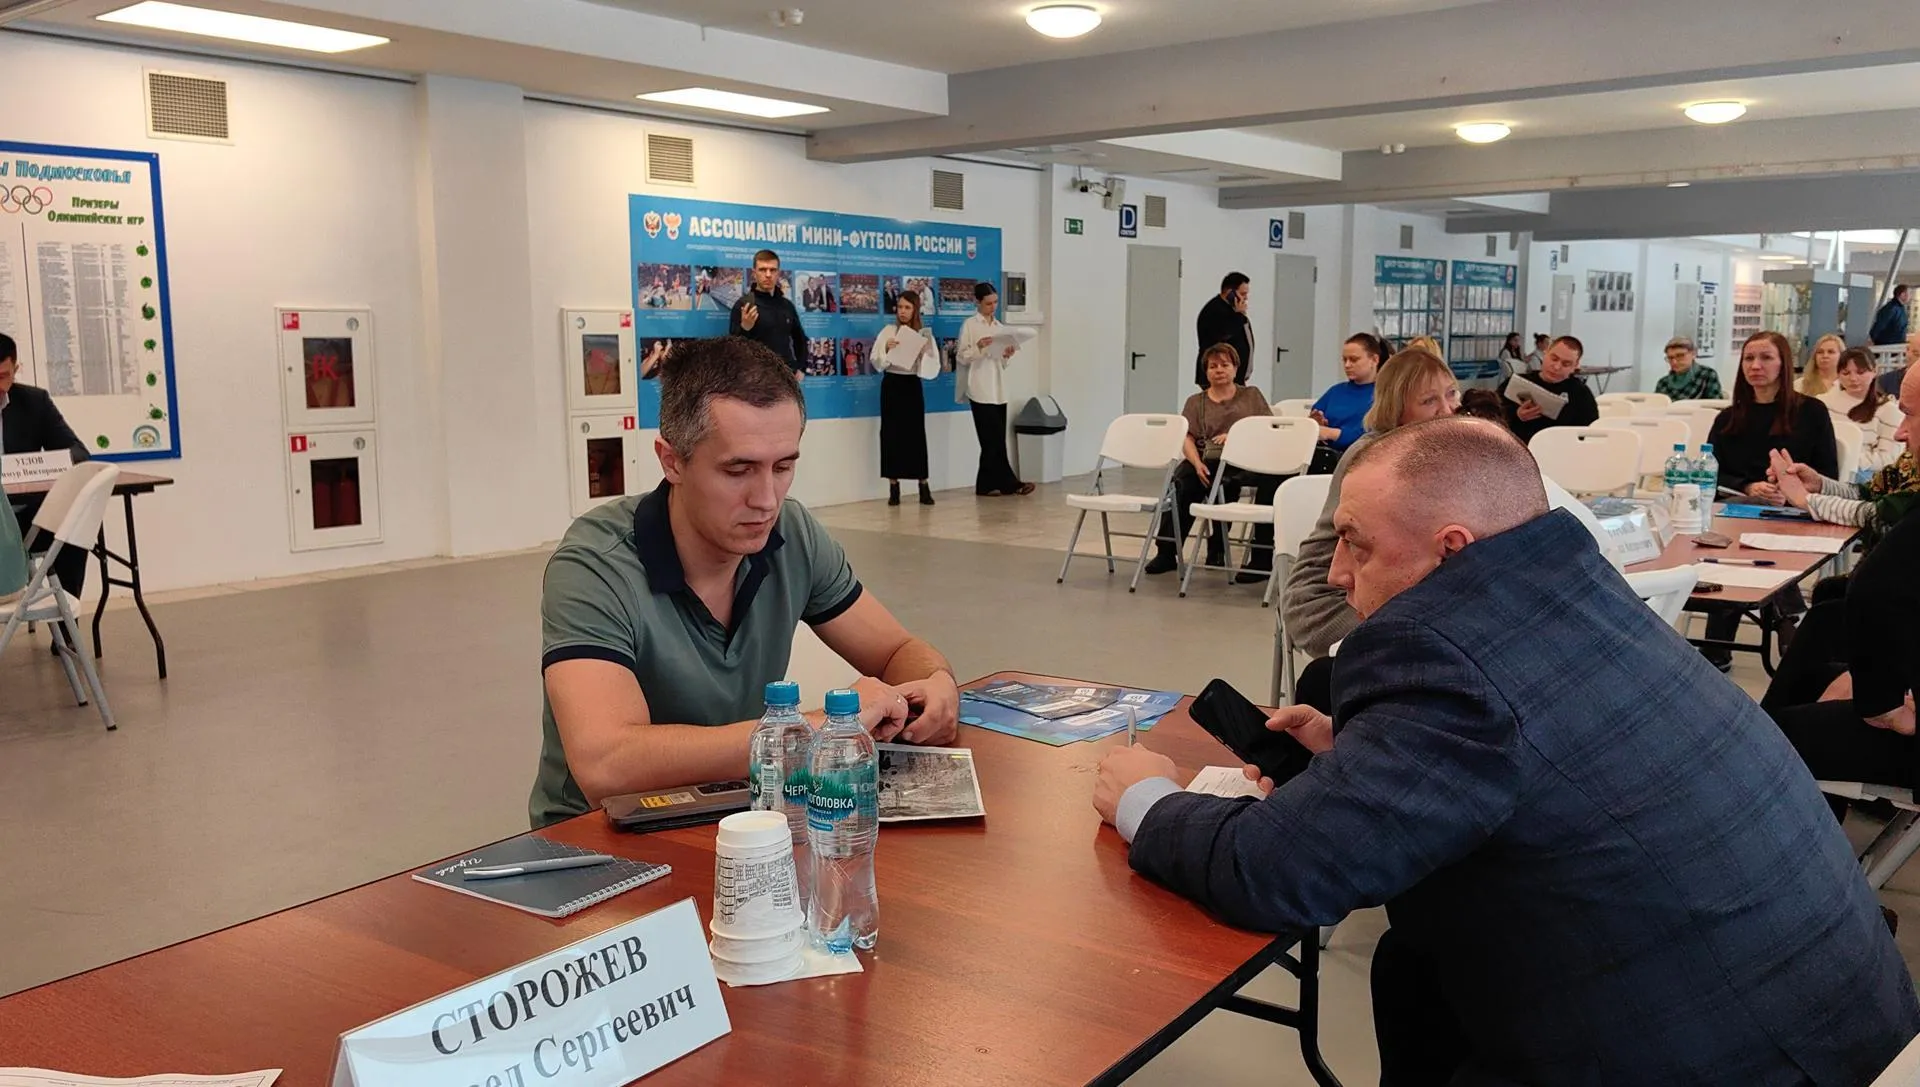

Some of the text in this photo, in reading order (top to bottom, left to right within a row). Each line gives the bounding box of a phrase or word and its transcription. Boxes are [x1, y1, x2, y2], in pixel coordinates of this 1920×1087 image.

[689, 216, 963, 254] АССОЦИАЦИЯ МИНИ-ФУТБОЛА РОССИИ
[1122, 207, 1136, 229] D
[431, 936, 648, 1055] СТОРОЖЕВ
[533, 984, 697, 1078] Сергеевич
